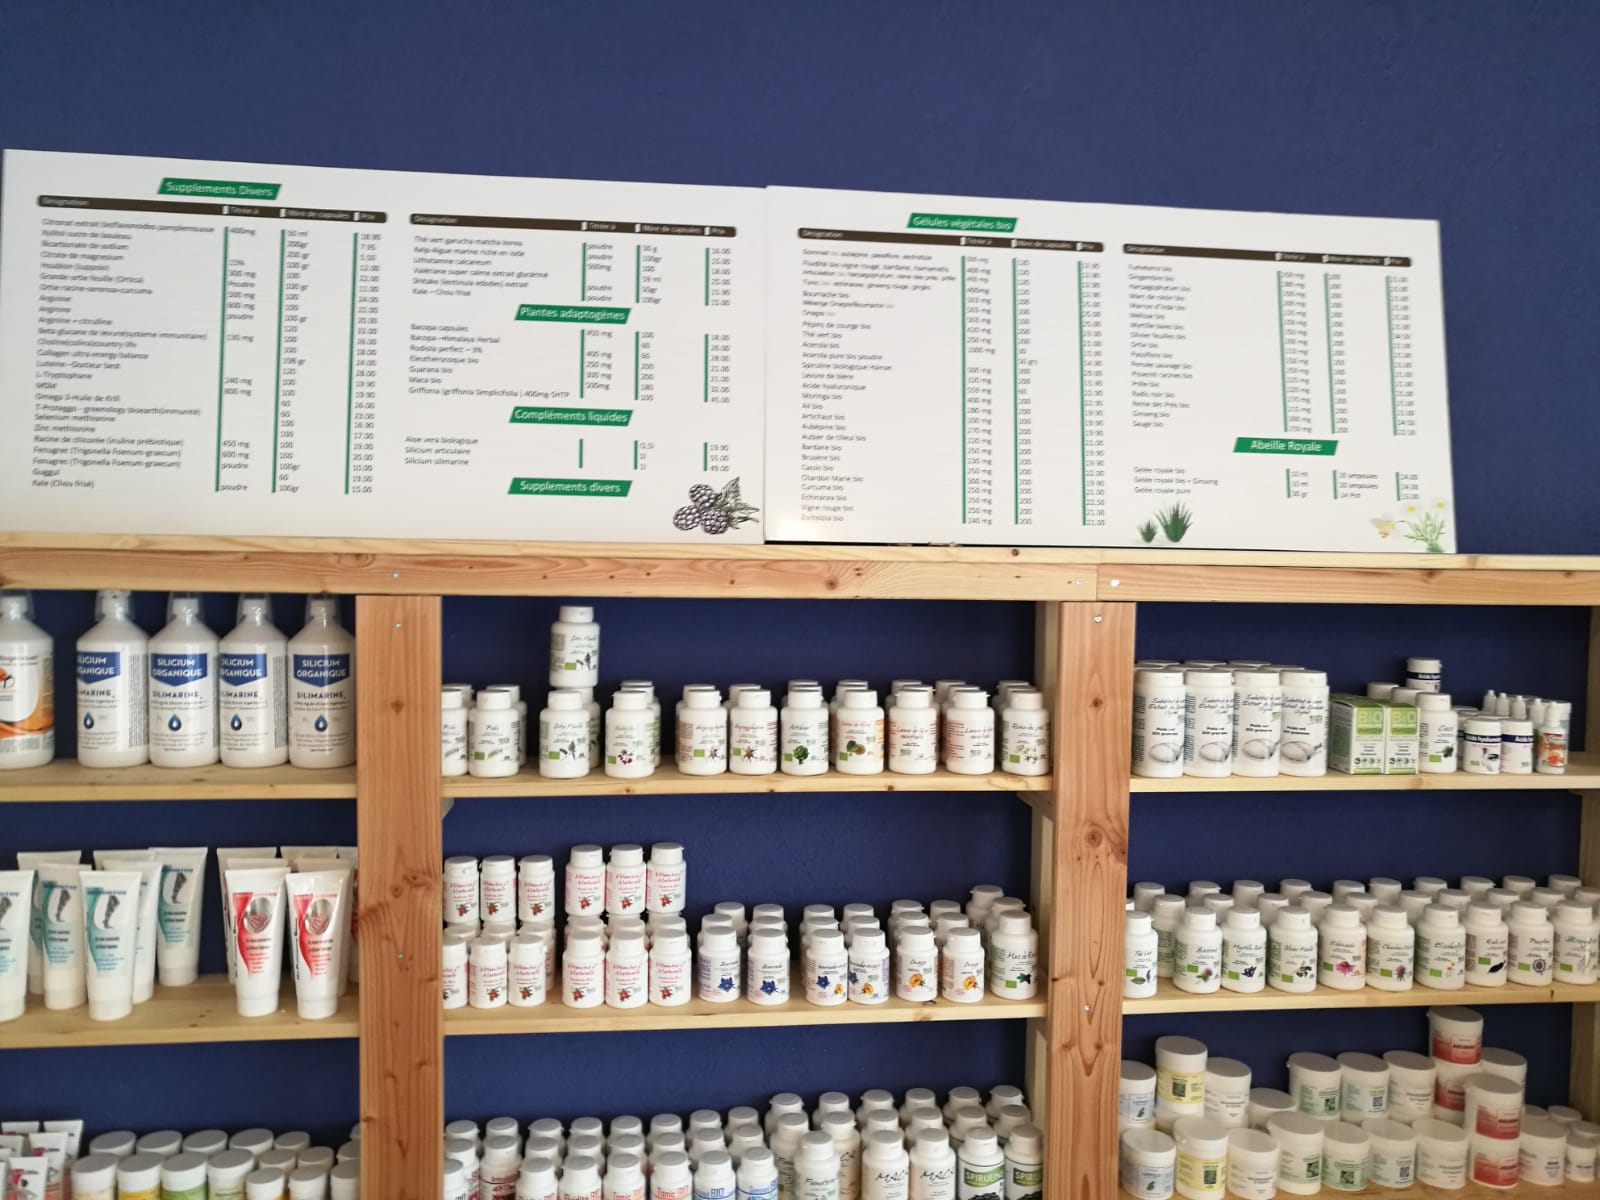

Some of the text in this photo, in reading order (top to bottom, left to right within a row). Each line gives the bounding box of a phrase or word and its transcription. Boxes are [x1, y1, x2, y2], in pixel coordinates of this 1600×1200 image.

[165, 182, 273, 197] Supplements Divers
[912, 216, 948, 228] Gélules
[997, 220, 1014, 231] bio
[520, 306, 626, 323] Plantes adaptogènes
[514, 409, 629, 424] Compléments liquides
[1250, 439, 1321, 455] Abeille Royale
[520, 481, 621, 494] Supplements divers
[157, 658, 196, 667] SILICIUM
[302, 659, 341, 667] SILICIUM
[152, 668, 203, 677] ORGANIQUE
[296, 669, 347, 677] ORGANIQUE
[152, 690, 200, 698] SILIMARINE
[297, 691, 344, 699] SILIMARINE
[966, 1170, 1003, 1181] SPIRULIN
